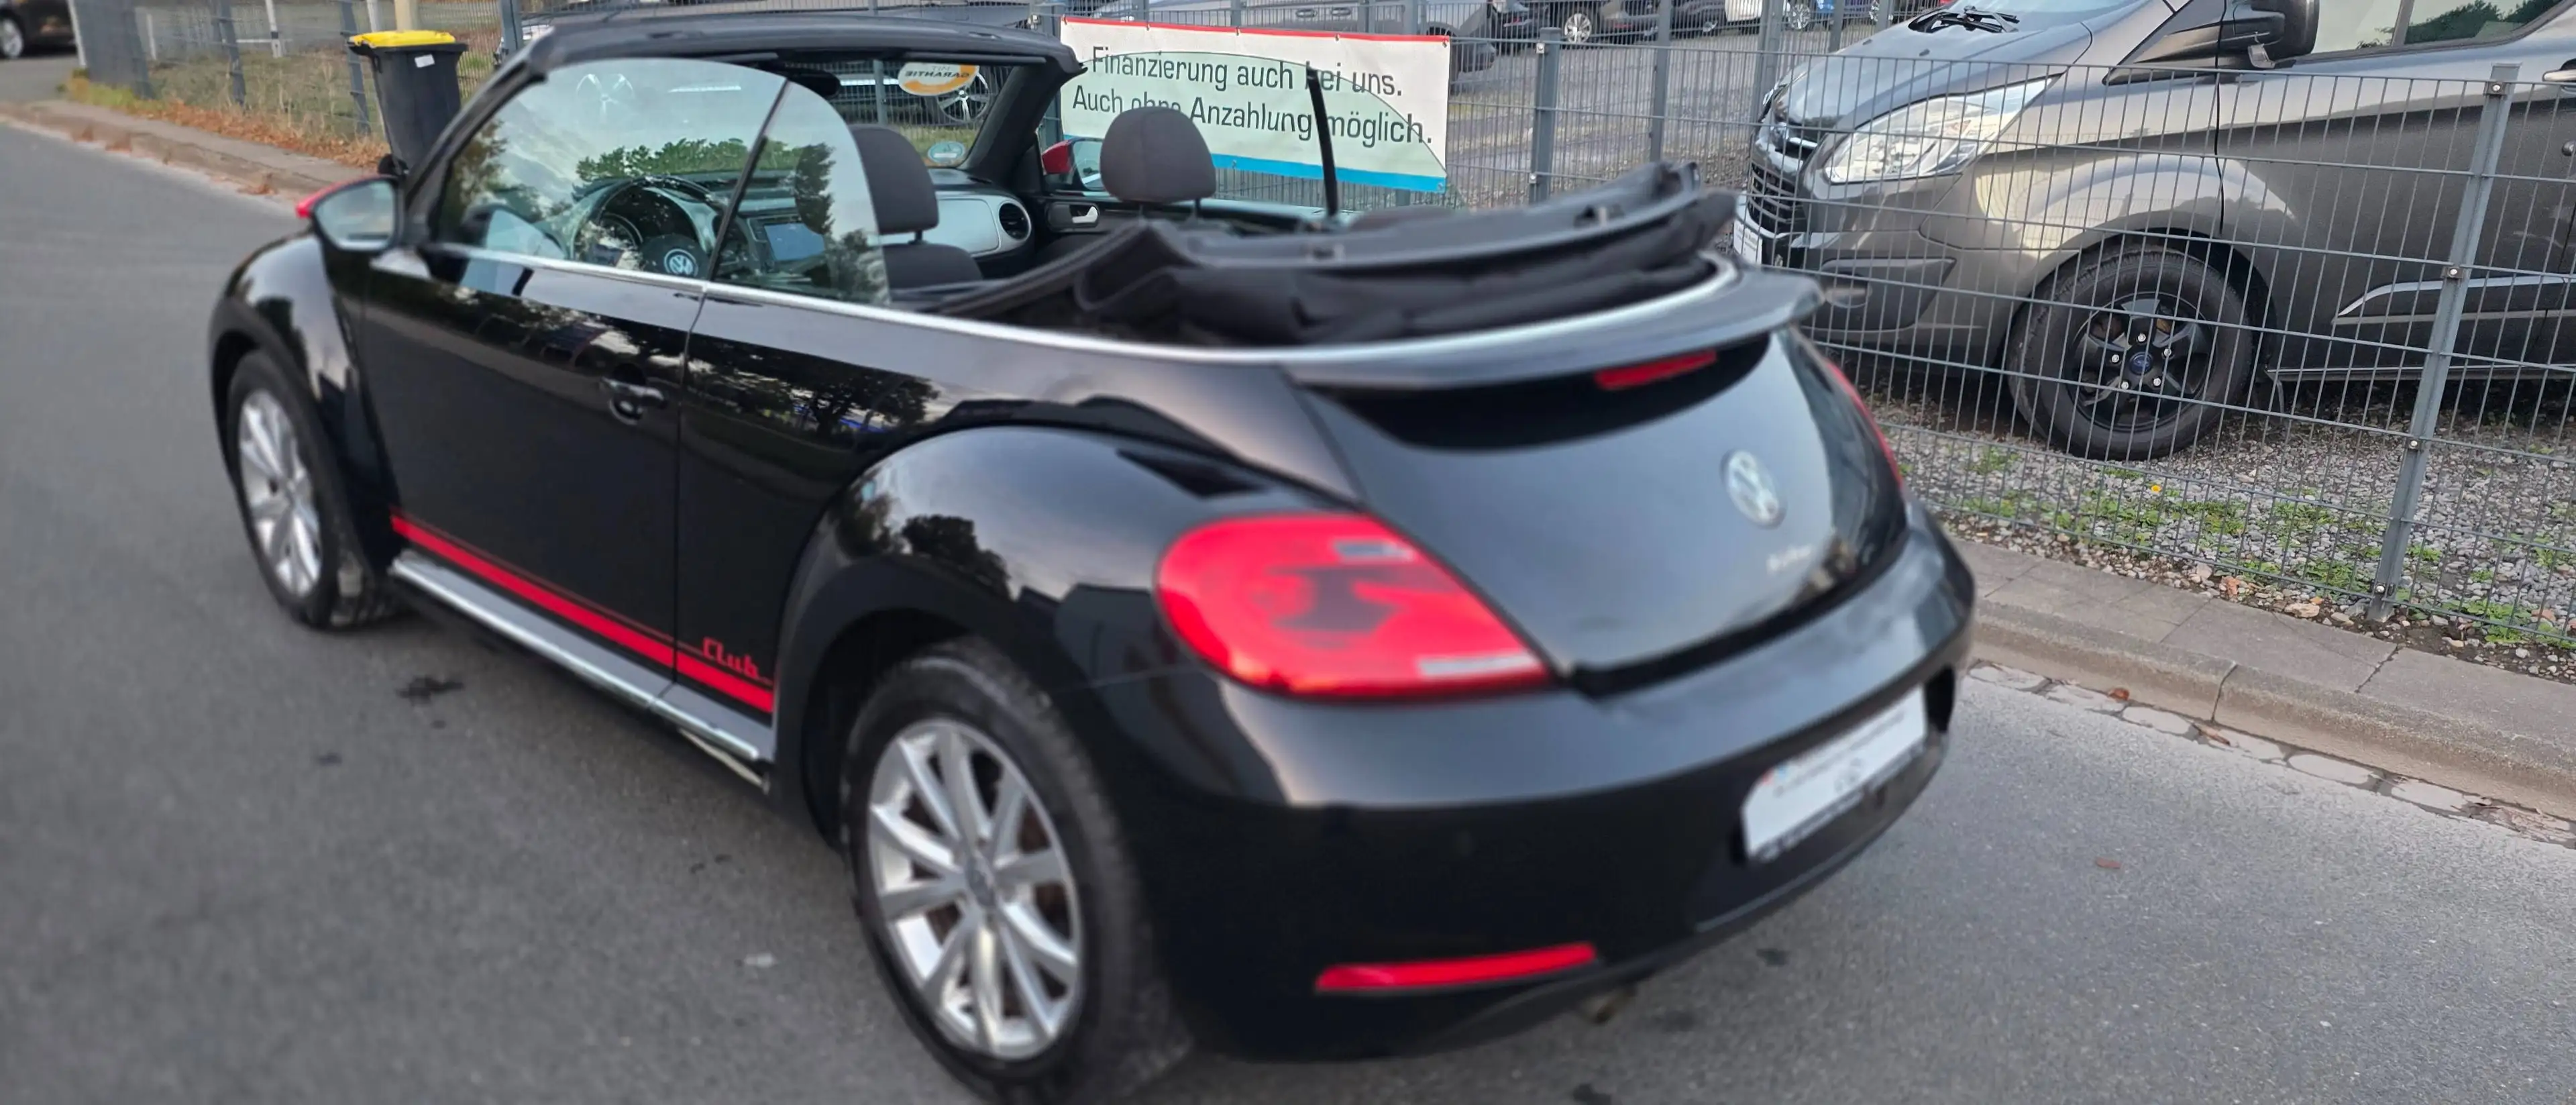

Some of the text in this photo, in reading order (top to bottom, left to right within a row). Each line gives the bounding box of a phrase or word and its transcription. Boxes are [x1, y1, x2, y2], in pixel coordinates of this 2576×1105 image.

[1093, 46, 1227, 92] Finanzierung
[1237, 61, 1293, 90] auch
[1352, 71, 1402, 96] uns.
[1073, 85, 1122, 113] Auch
[1190, 97, 1311, 141] Anzahlung
[1327, 111, 1432, 148] möglich.
